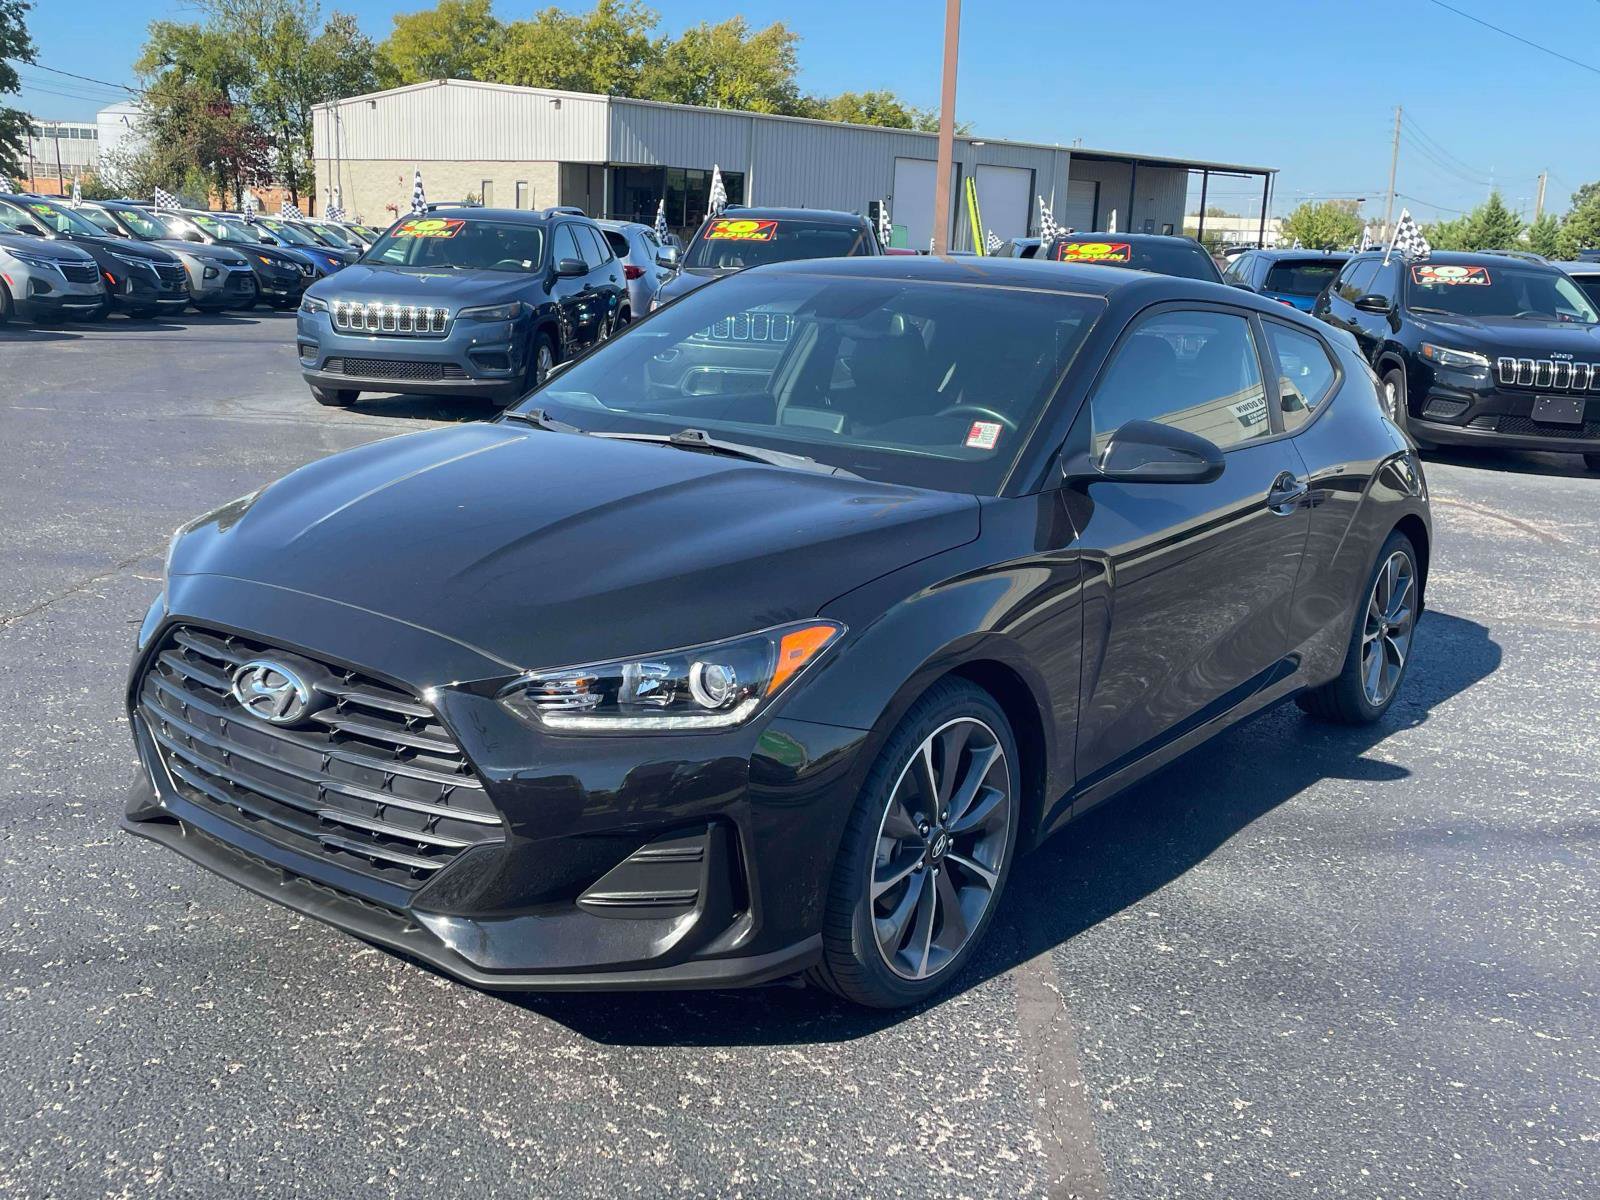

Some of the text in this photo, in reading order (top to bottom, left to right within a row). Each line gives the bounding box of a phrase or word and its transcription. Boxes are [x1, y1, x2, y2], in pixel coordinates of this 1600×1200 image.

[397, 229, 453, 237] DOWN
[711, 231, 768, 239] DOWN
[1064, 252, 1125, 260] DOWN
[1422, 276, 1485, 284] DOWN
[1550, 352, 1574, 360] Jeep
